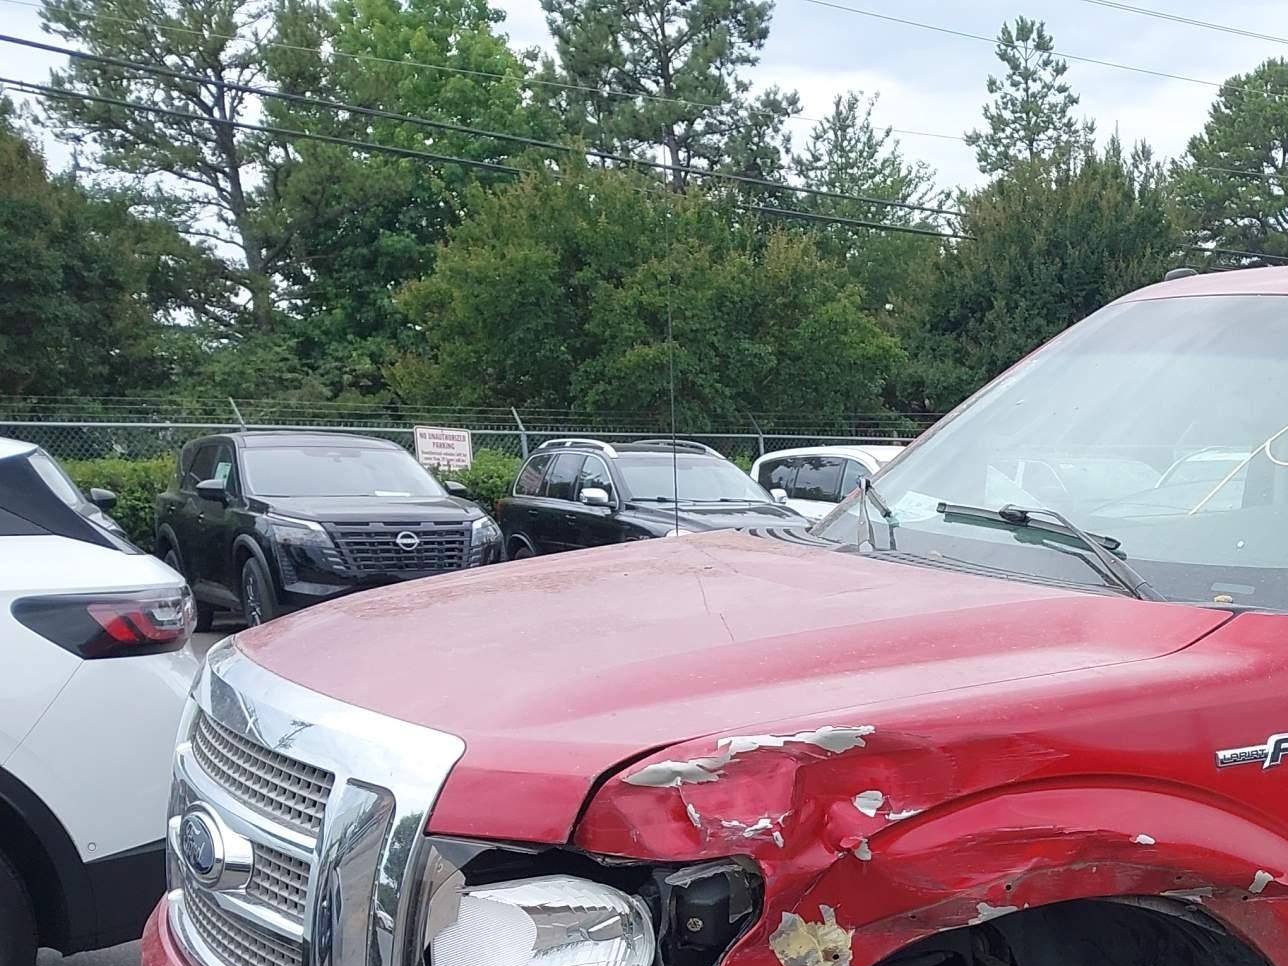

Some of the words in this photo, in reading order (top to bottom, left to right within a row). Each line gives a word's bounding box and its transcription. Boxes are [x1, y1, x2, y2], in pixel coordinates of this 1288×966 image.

[419, 432, 427, 440] NO
[432, 441, 455, 450] PARKING
[1221, 747, 1267, 762] LARIAT
